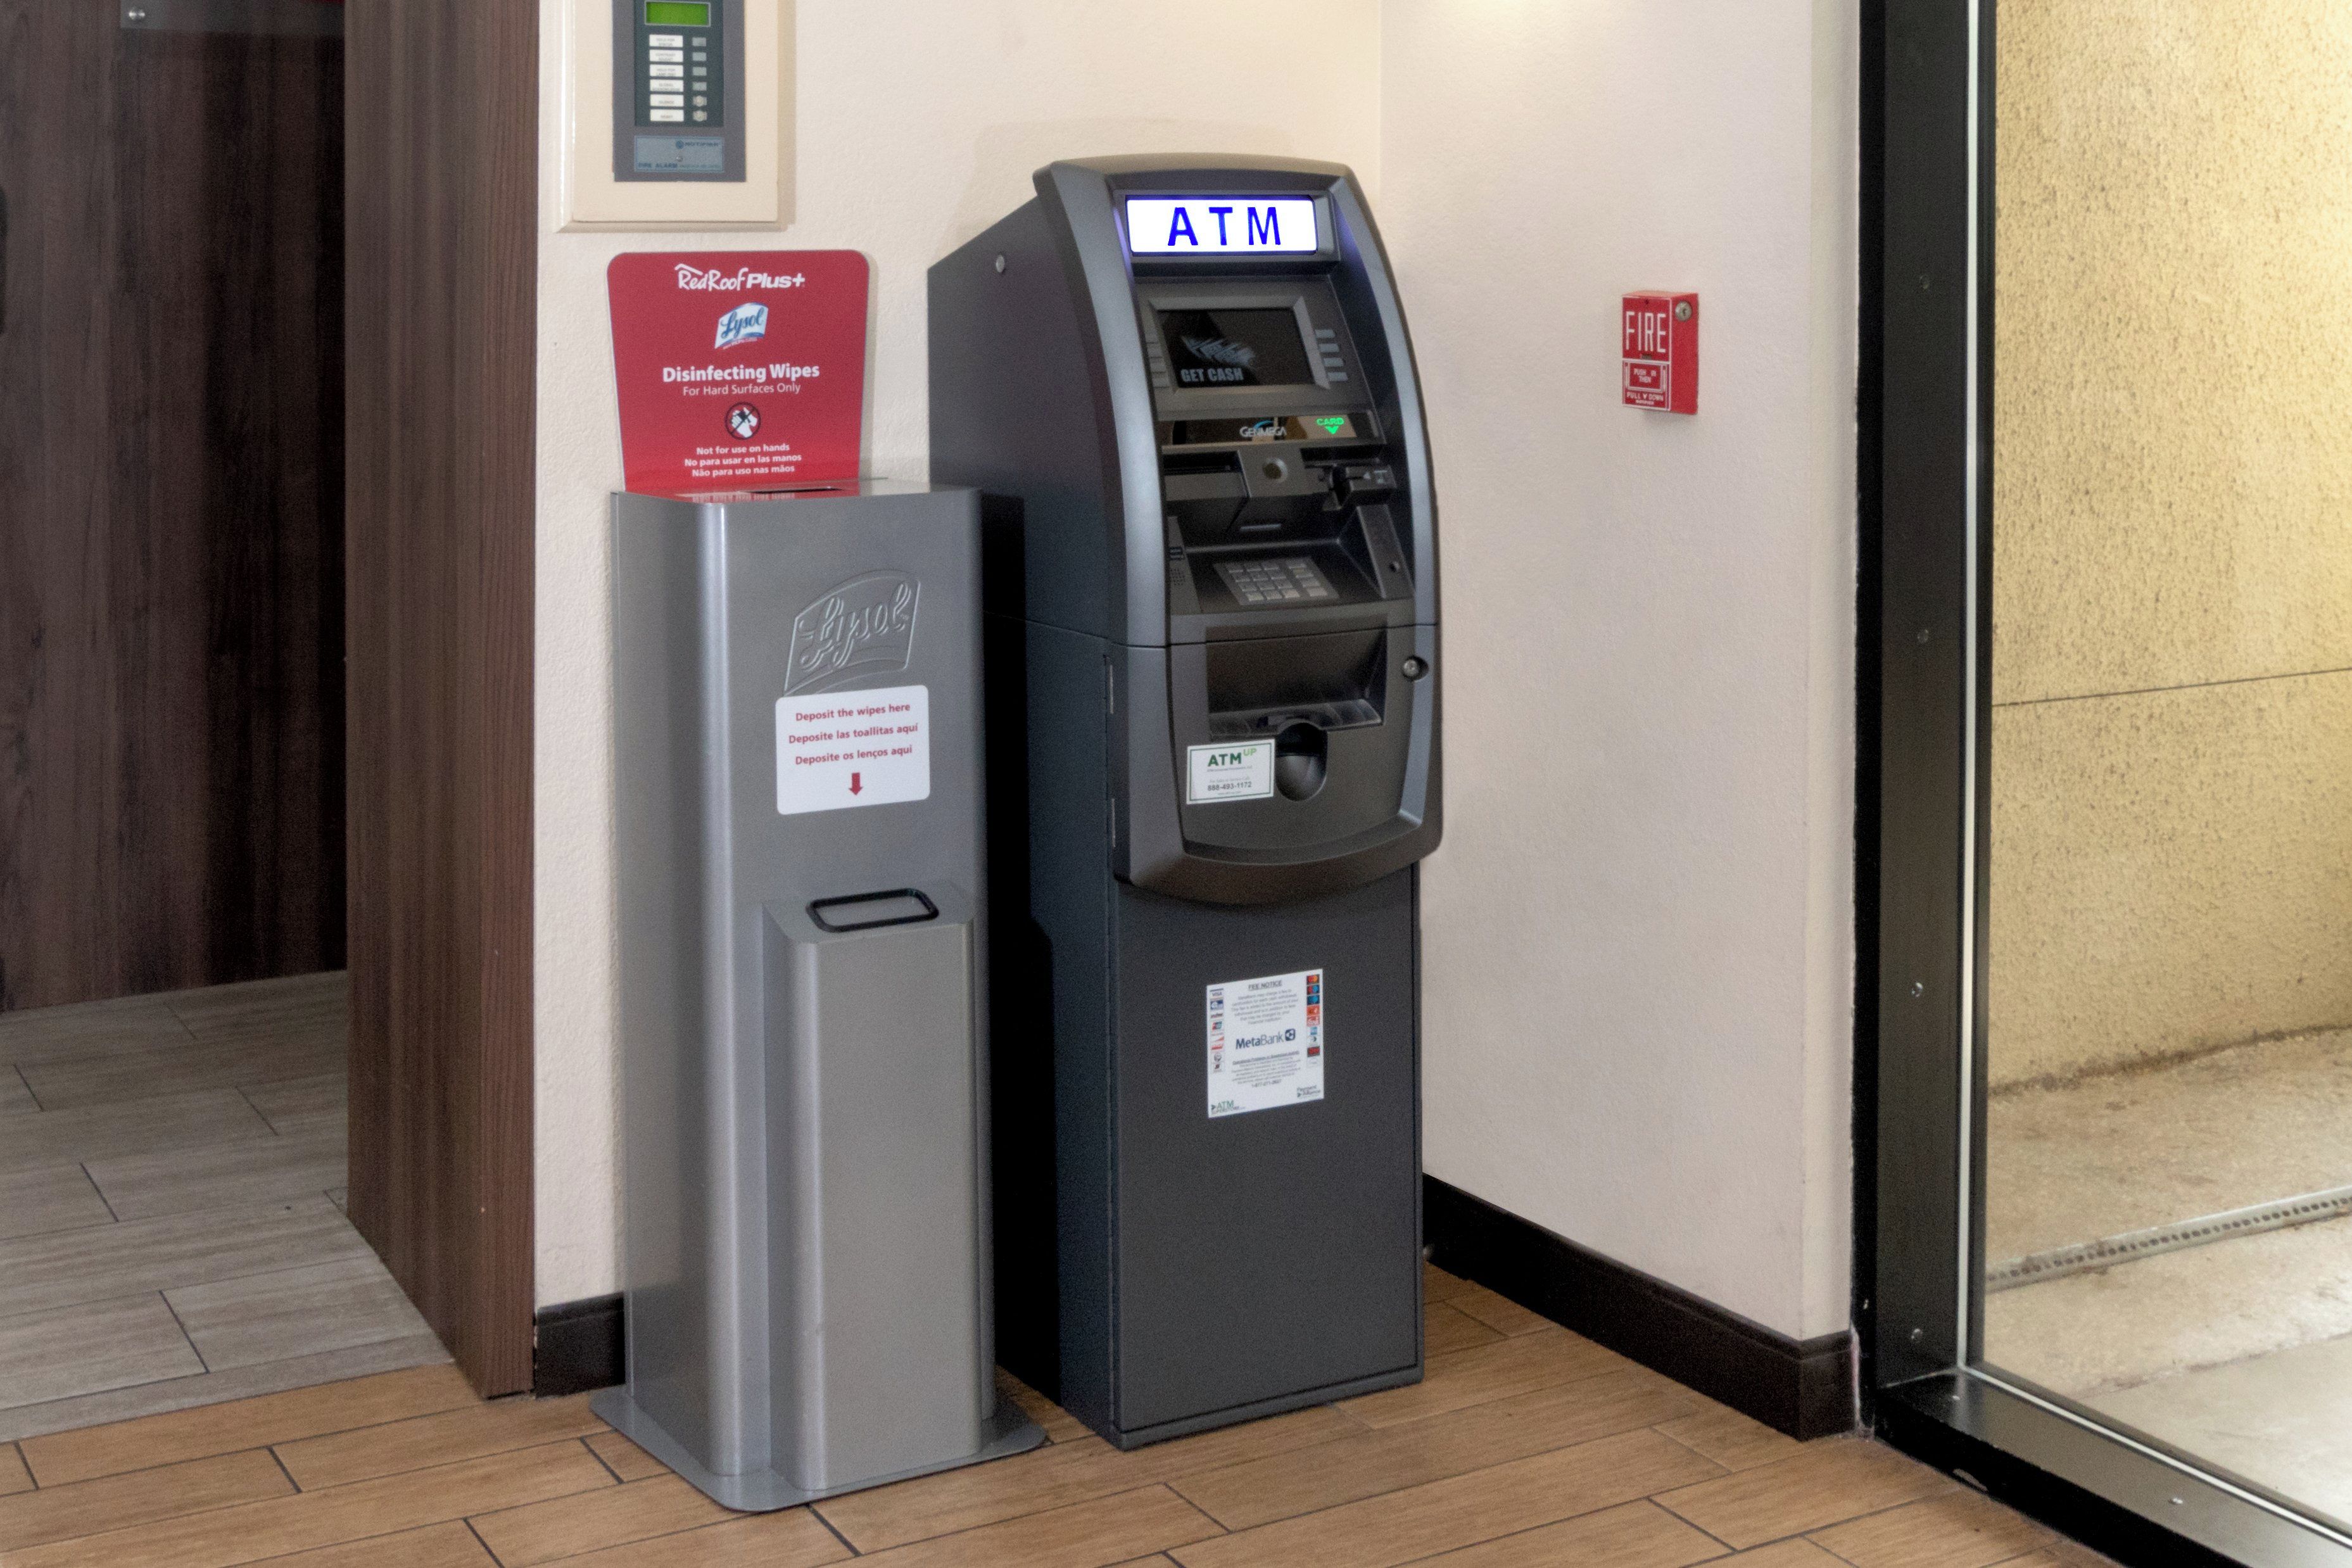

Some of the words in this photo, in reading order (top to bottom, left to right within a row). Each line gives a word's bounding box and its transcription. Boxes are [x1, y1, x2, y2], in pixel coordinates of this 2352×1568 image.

[1168, 206, 1280, 246] ATM
[720, 307, 765, 339] Lysol
[1626, 311, 1666, 353] FIRE
[662, 365, 766, 383] Disinfecting
[769, 363, 819, 381] Wipes
[1180, 368, 1204, 383] GET
[1207, 367, 1244, 381] CASH
[683, 386, 700, 396] For
[703, 385, 728, 395] Hard
[731, 384, 774, 395] Surfaces
[777, 383, 801, 394] Only
[1316, 417, 1344, 426] CARD
[716, 446, 730, 454] for
[763, 443, 790, 452] hands
[692, 469, 710, 477] Não
[712, 469, 733, 477] para
[771, 465, 795, 473] mãos
[700, 458, 720, 467] para
[797, 581, 911, 673] Lysol
[795, 710, 835, 722] Deposit
[837, 708, 854, 718] the
[857, 706, 886, 716] wipes
[888, 704, 910, 712] here
[788, 731, 833, 744] Deposite
[837, 730, 850, 739] las
[853, 726, 894, 737] toallitas
[795, 752, 840, 765] Deposite
[857, 748, 888, 759] lenços
[1208, 752, 1242, 767] ATM
[1243, 748, 1257, 756] UP
[1207, 781, 1252, 792] 888-493-1172
[1261, 980, 1282, 989] NOTICE
[1236, 1032, 1284, 1050] MetaBank
[1217, 1100, 1234, 1113] ATM
